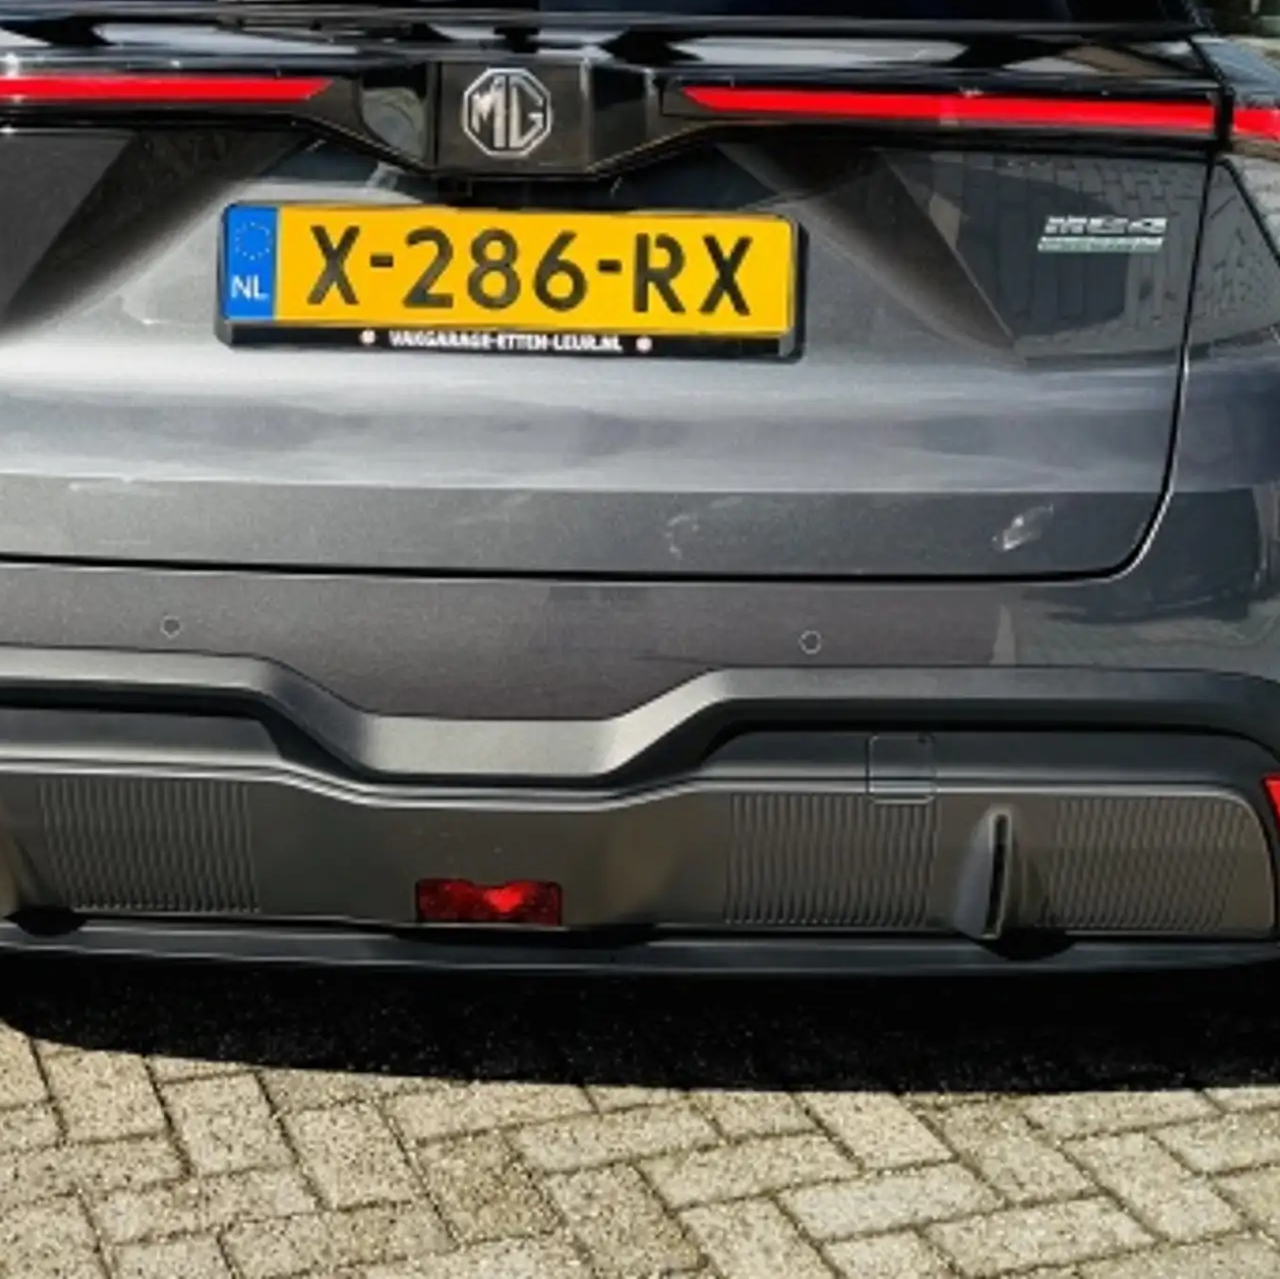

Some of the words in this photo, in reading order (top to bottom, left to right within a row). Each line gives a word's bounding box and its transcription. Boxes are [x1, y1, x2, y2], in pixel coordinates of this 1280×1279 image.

[464, 69, 551, 157] MG
[231, 274, 269, 300] NL
[306, 225, 754, 316] X-286-RX
